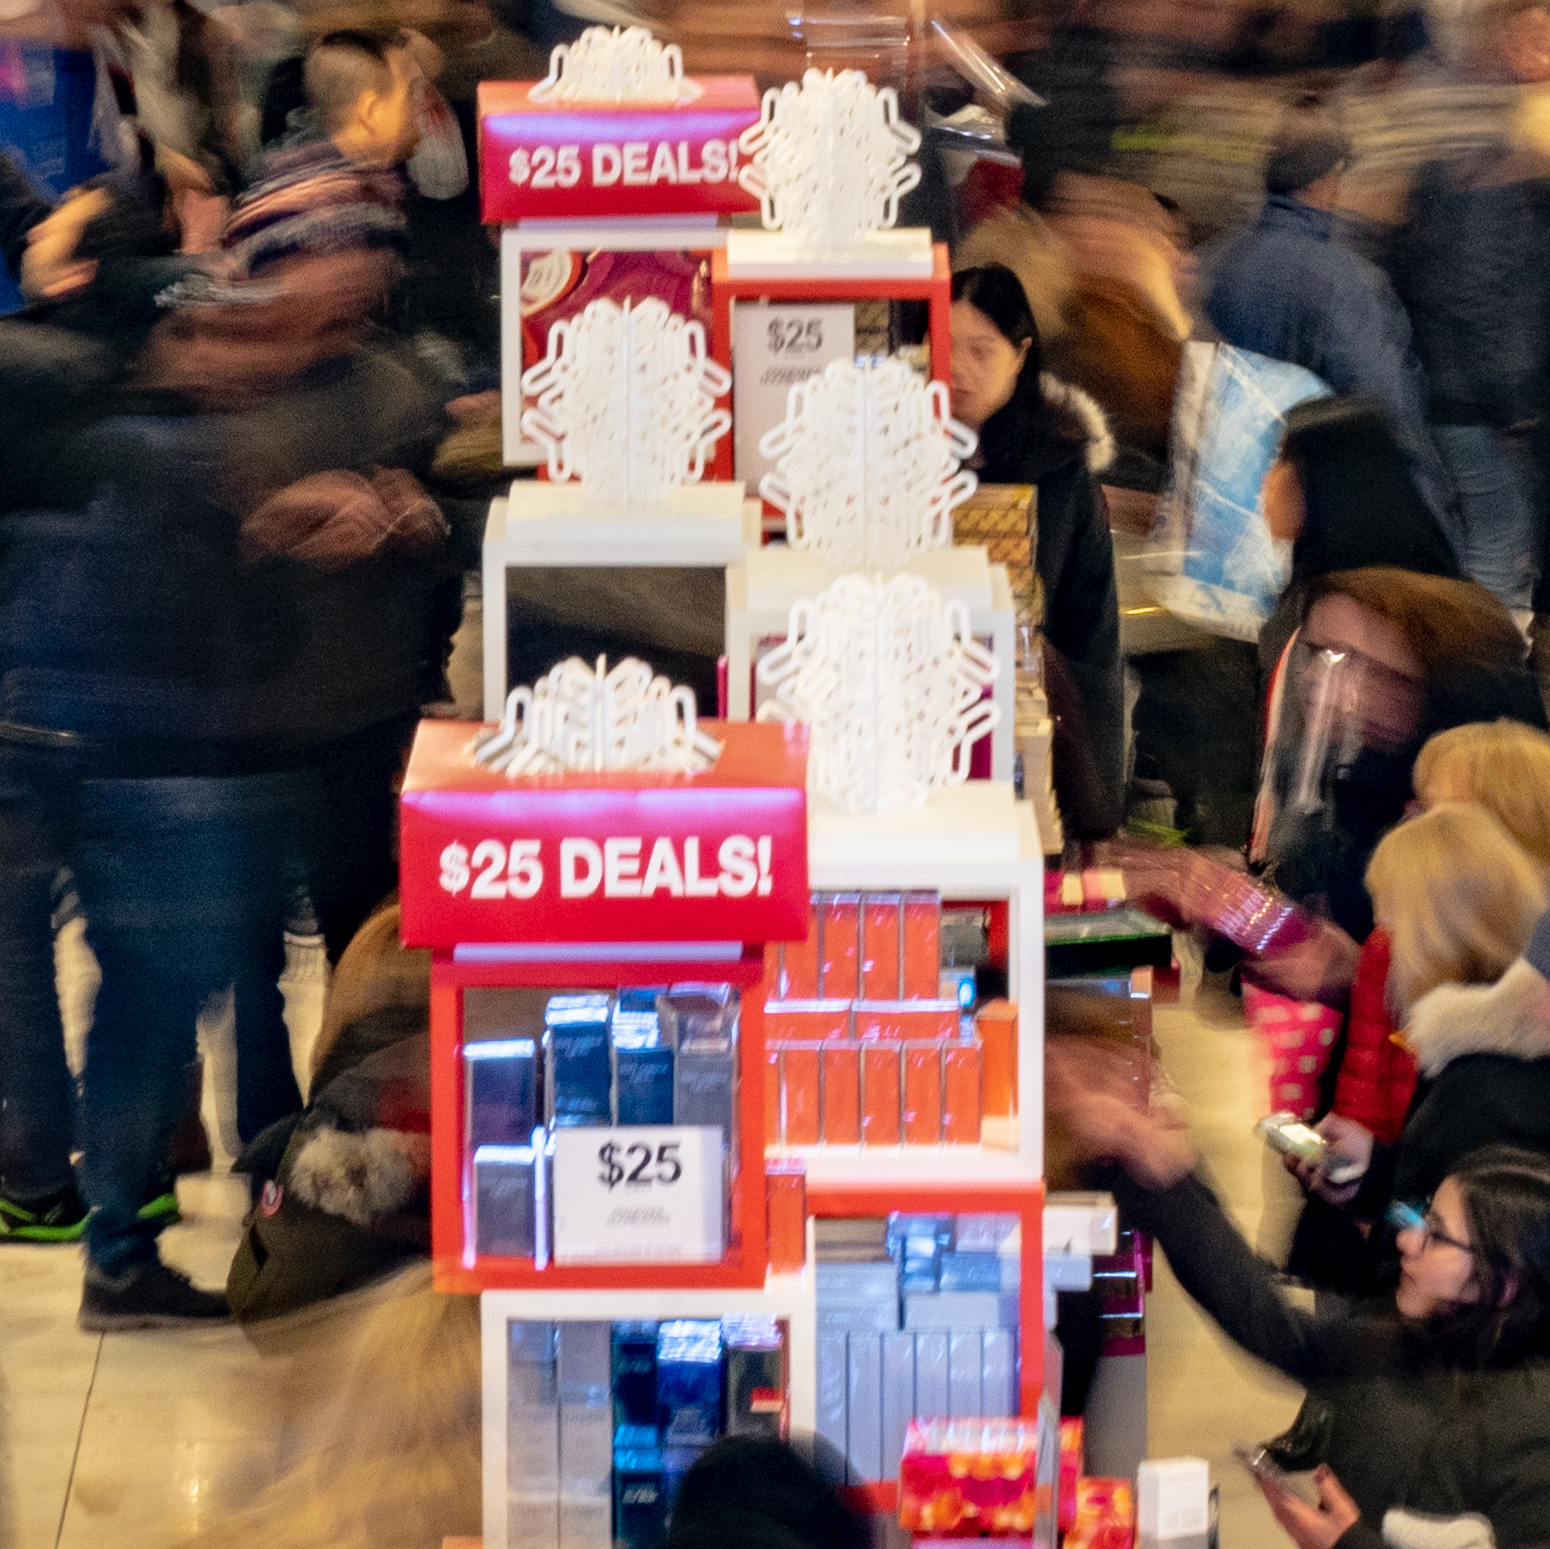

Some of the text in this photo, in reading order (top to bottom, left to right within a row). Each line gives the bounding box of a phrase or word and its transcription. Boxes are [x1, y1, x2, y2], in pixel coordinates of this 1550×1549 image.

[509, 140, 739, 189] $25 DEALS!
[767, 317, 823, 355] $25
[439, 834, 773, 899] $25 DEALS!
[597, 1139, 683, 1192] $25
